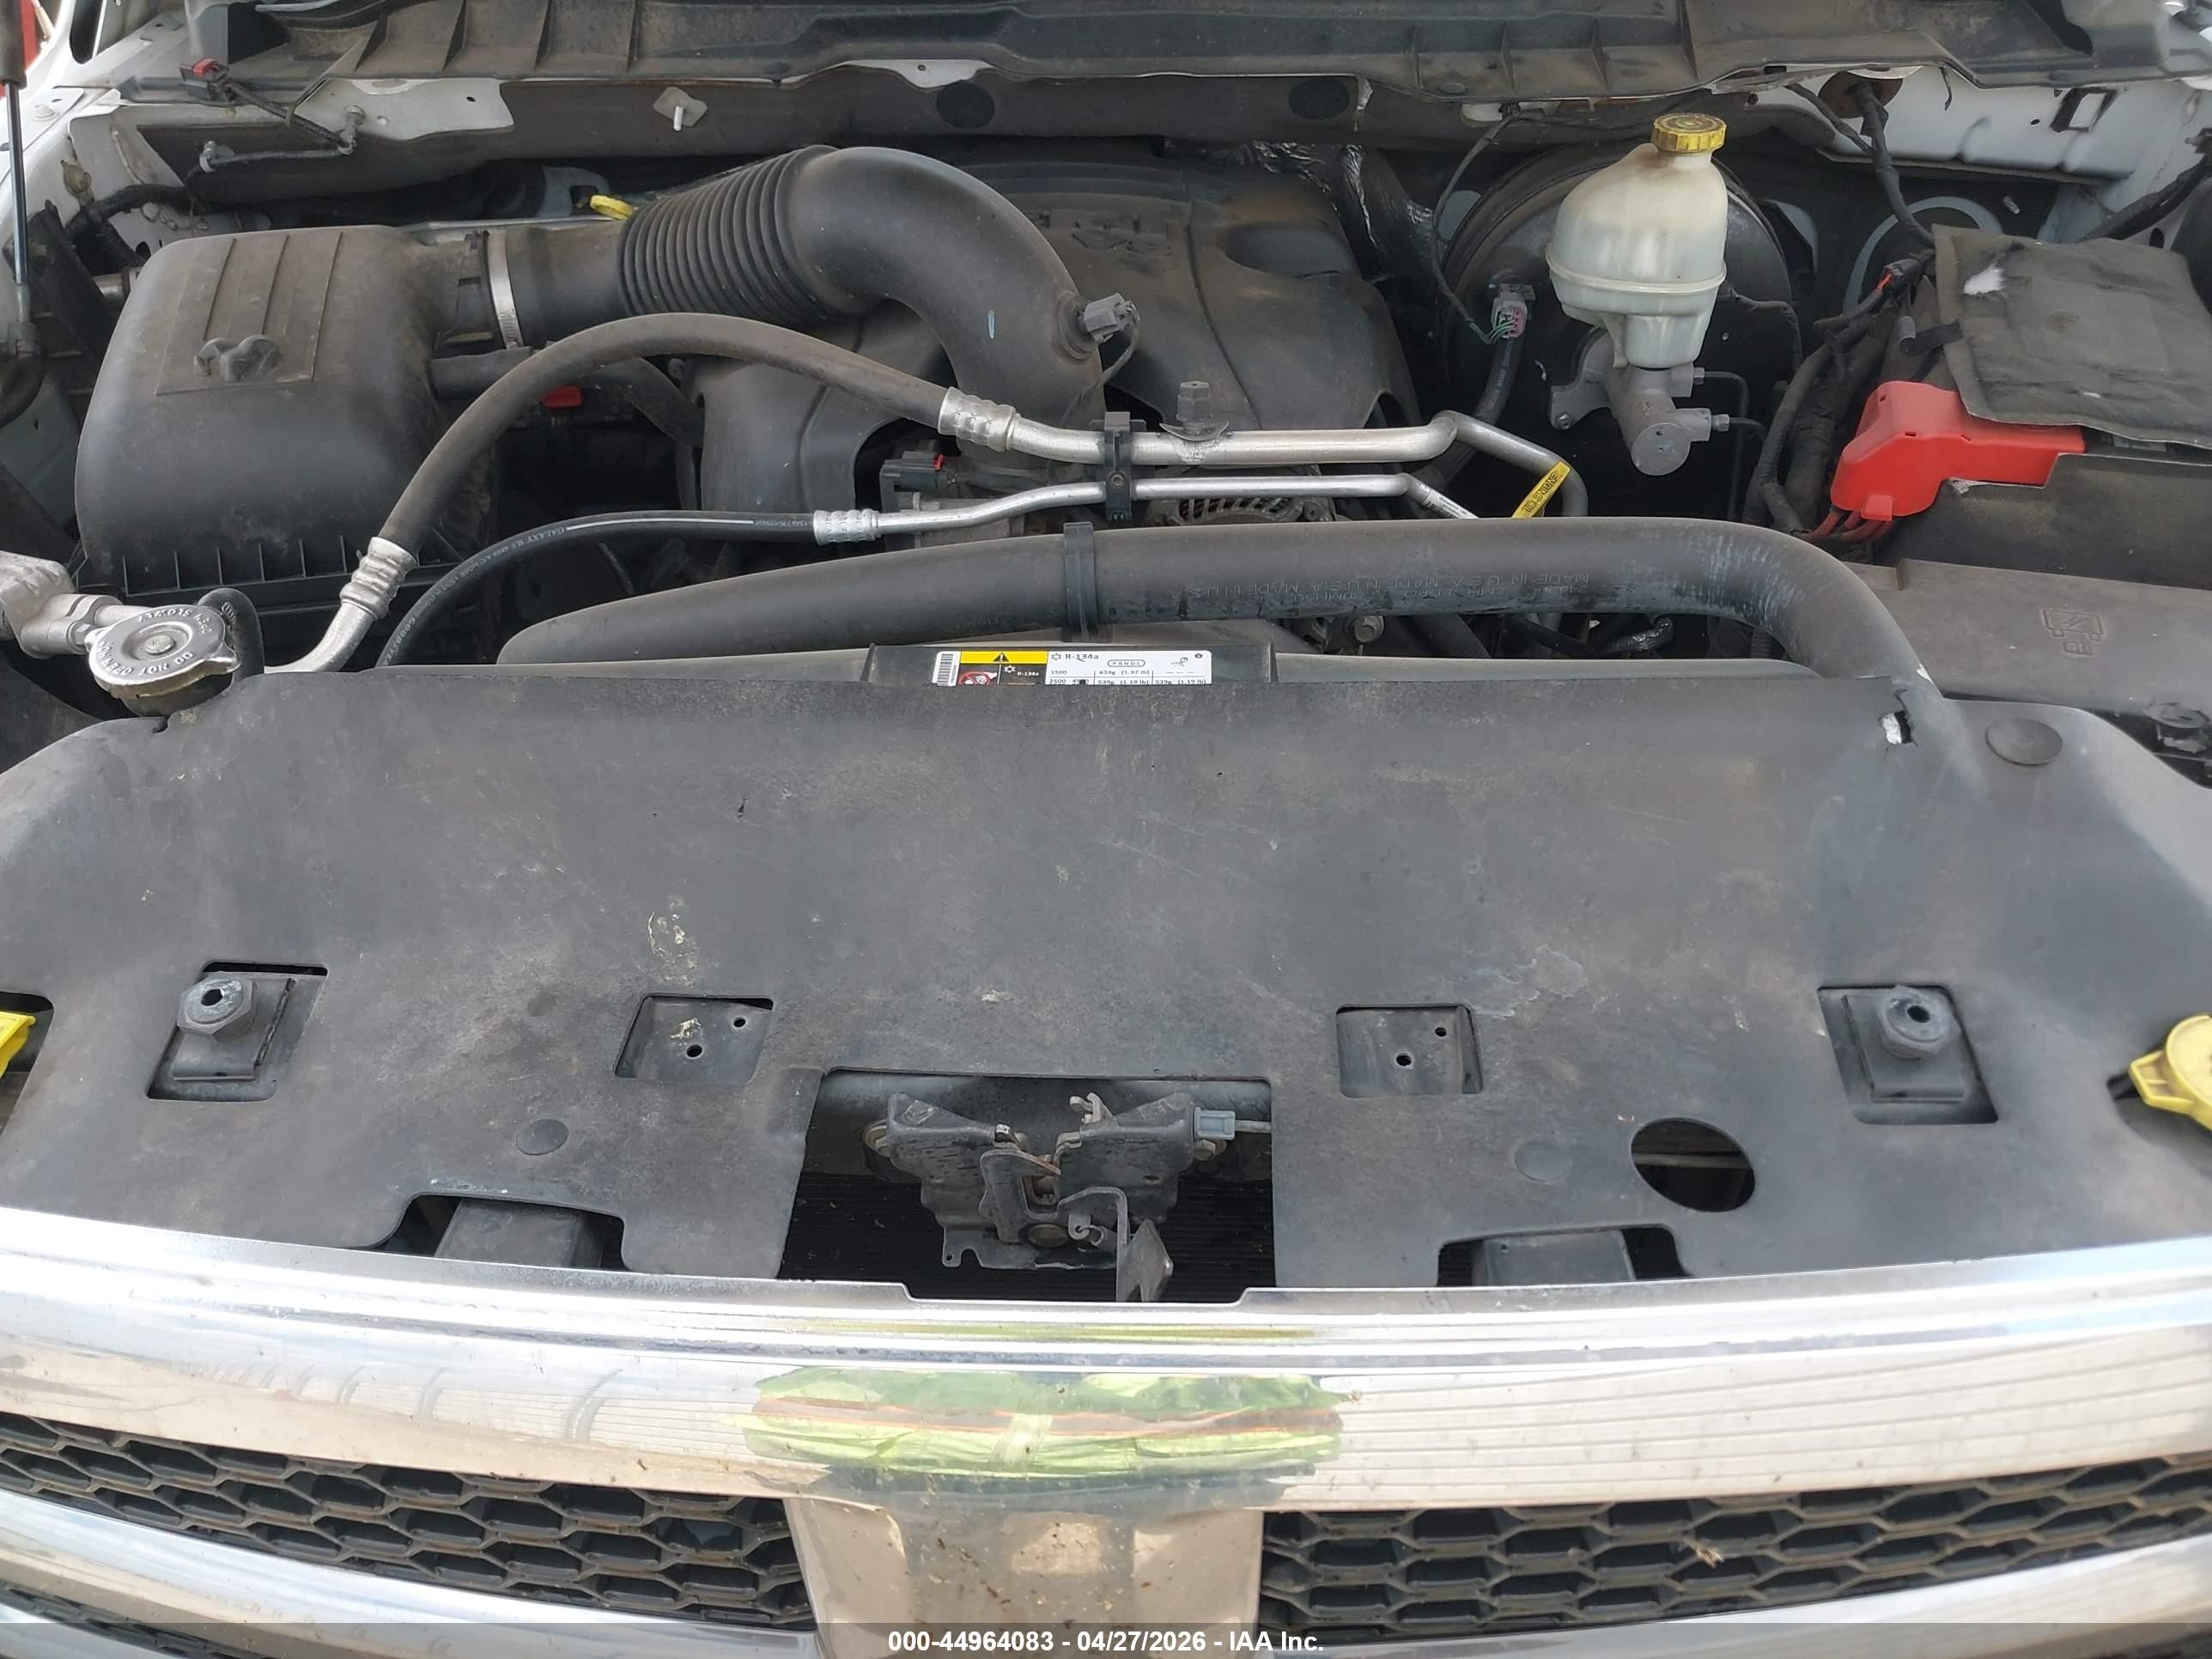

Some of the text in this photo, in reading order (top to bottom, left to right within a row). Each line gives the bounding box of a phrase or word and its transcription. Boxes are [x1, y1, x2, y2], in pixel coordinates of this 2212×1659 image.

[1522, 471, 1559, 514] ENGINE OIL
[173, 650, 194, 665] DO
[137, 662, 169, 676] NOT
